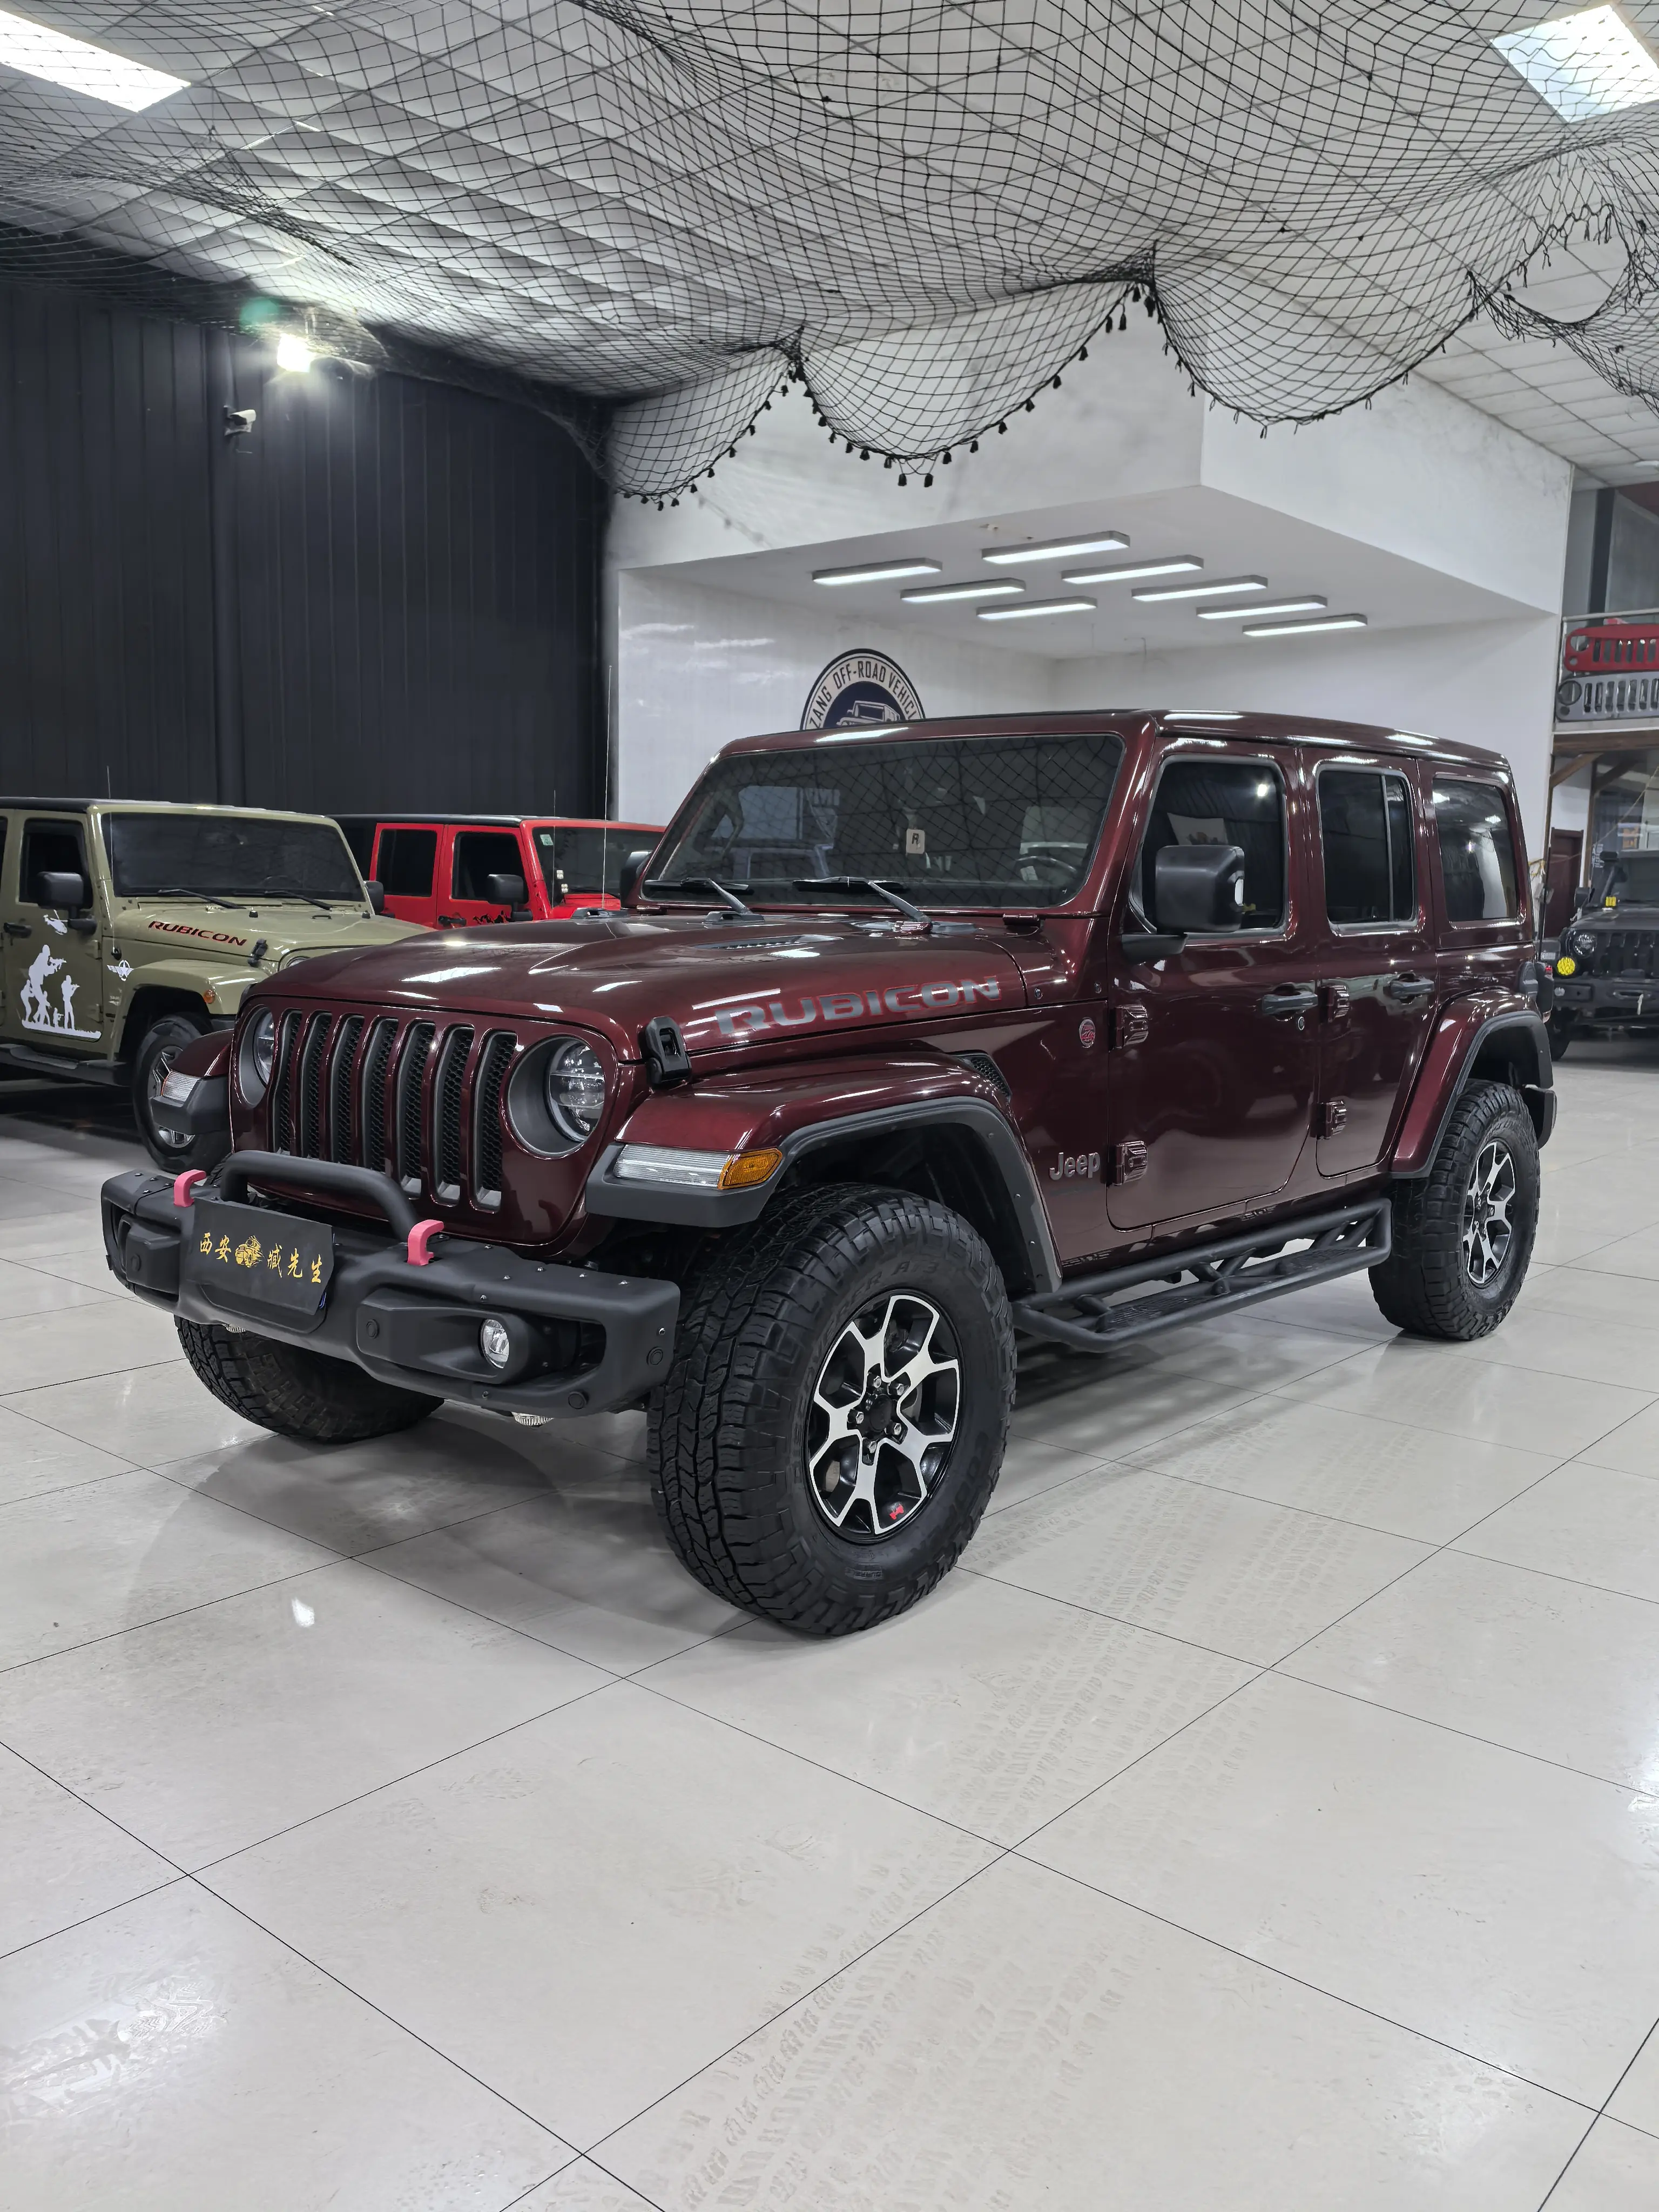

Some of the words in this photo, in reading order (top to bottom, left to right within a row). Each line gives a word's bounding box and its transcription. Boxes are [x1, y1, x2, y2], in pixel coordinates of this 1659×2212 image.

[810, 685, 833, 729] ZANG
[833, 660, 887, 690] OFF-ROAD
[149, 920, 247, 946] RUBICON
[714, 975, 1002, 1035] RUBICON
[1049, 1151, 1101, 1181] Jeep
[200, 1232, 232, 1263] 西安
